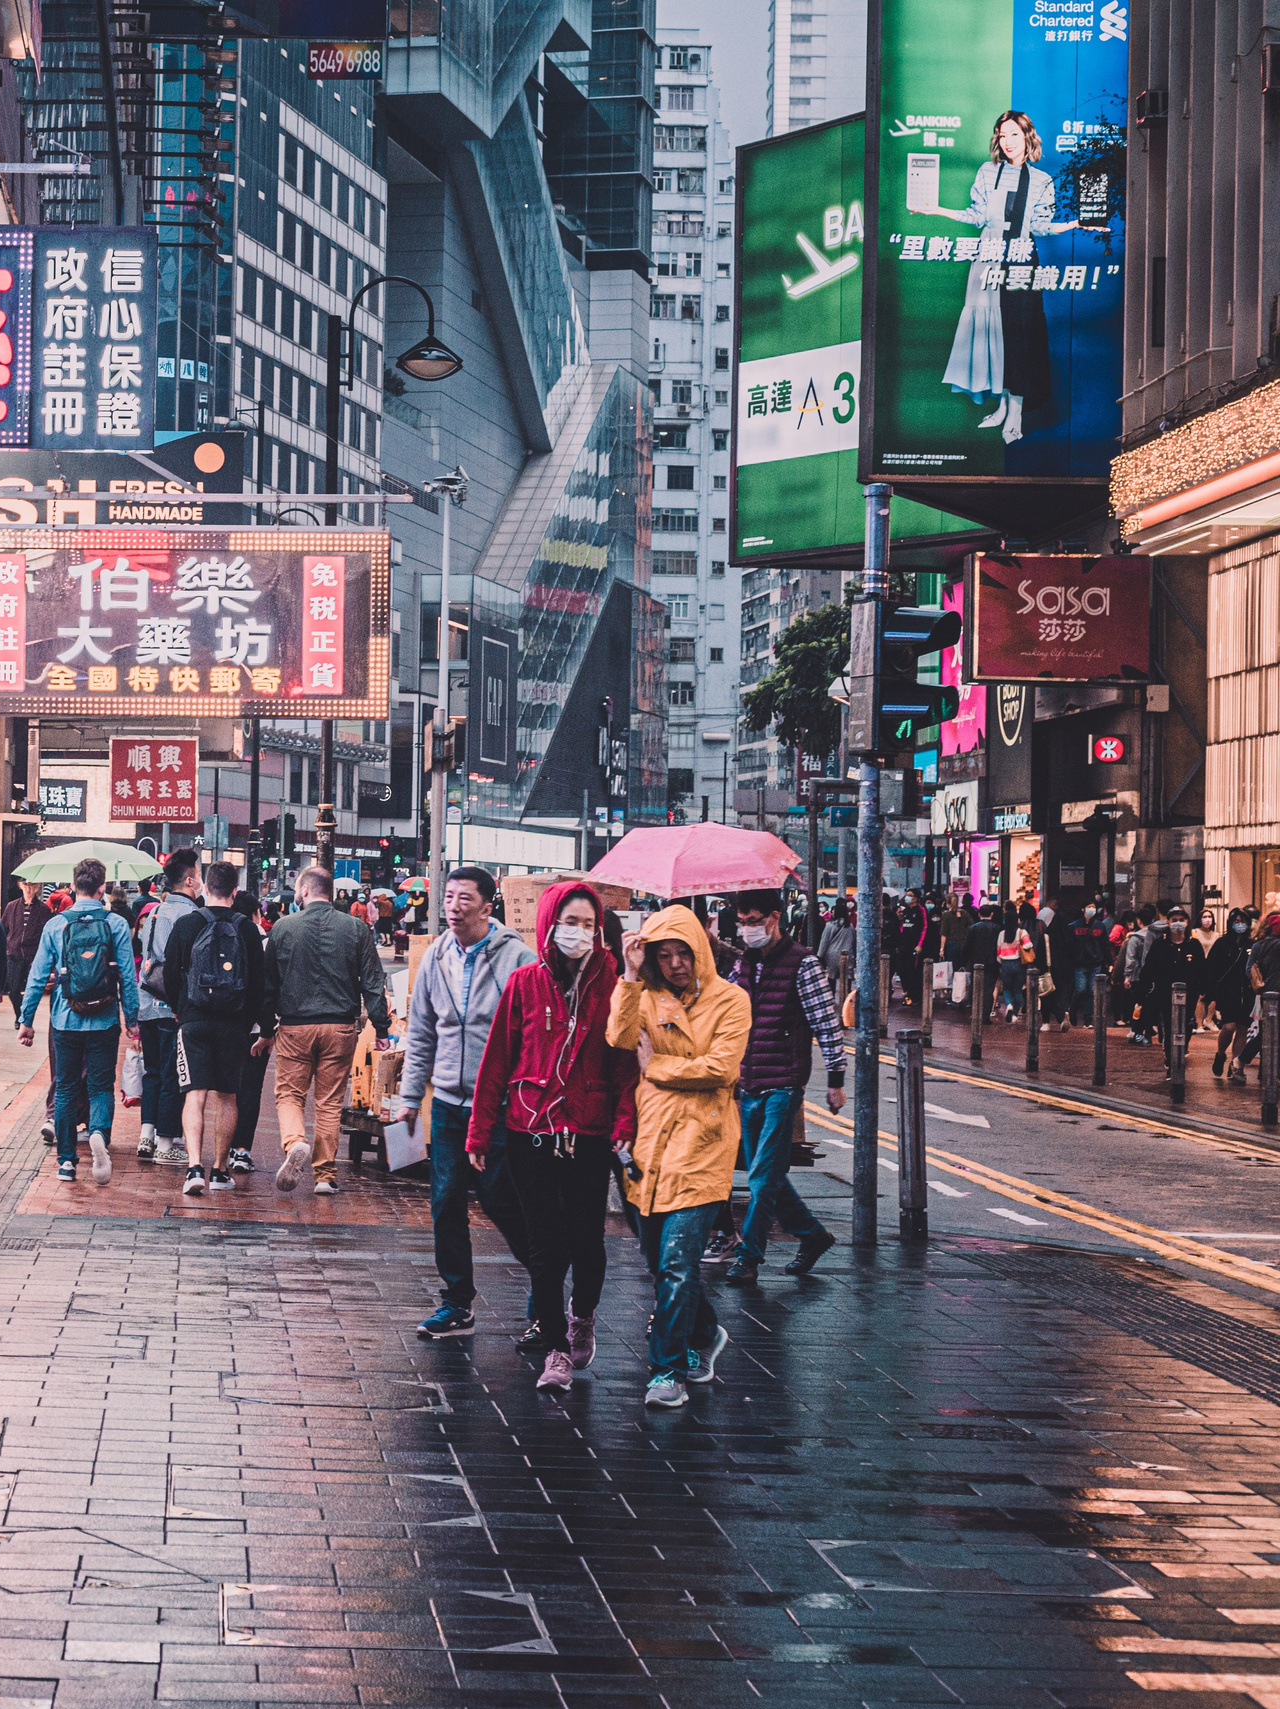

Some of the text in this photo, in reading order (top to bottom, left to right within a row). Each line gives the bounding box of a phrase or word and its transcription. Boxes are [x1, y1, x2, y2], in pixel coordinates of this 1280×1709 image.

[1034, 0, 1094, 13] Standard
[1029, 14, 1094, 27] Chartered
[1045, 30, 1093, 42] 渣打銀行
[309, 49, 381, 73] 5649 6988
[906, 115, 962, 128] BANKING
[43, 247, 89, 437] 政府註冊
[96, 247, 146, 437] 信心保證
[747, 378, 793, 419] 高達
[108, 506, 204, 521] HANDMADE
[67, 555, 263, 615] 伯樂
[56, 615, 272, 666] 大藥坊
[1038, 618, 1087, 642] 莎莎
[46, 665, 281, 693] 全國特快郵寄
[1002, 700, 1020, 723] SHOP
[127, 744, 183, 773] 順興
[43, 807, 82, 816] JEWELLERY
[112, 805, 195, 817] SHUN HING JADE CO.
